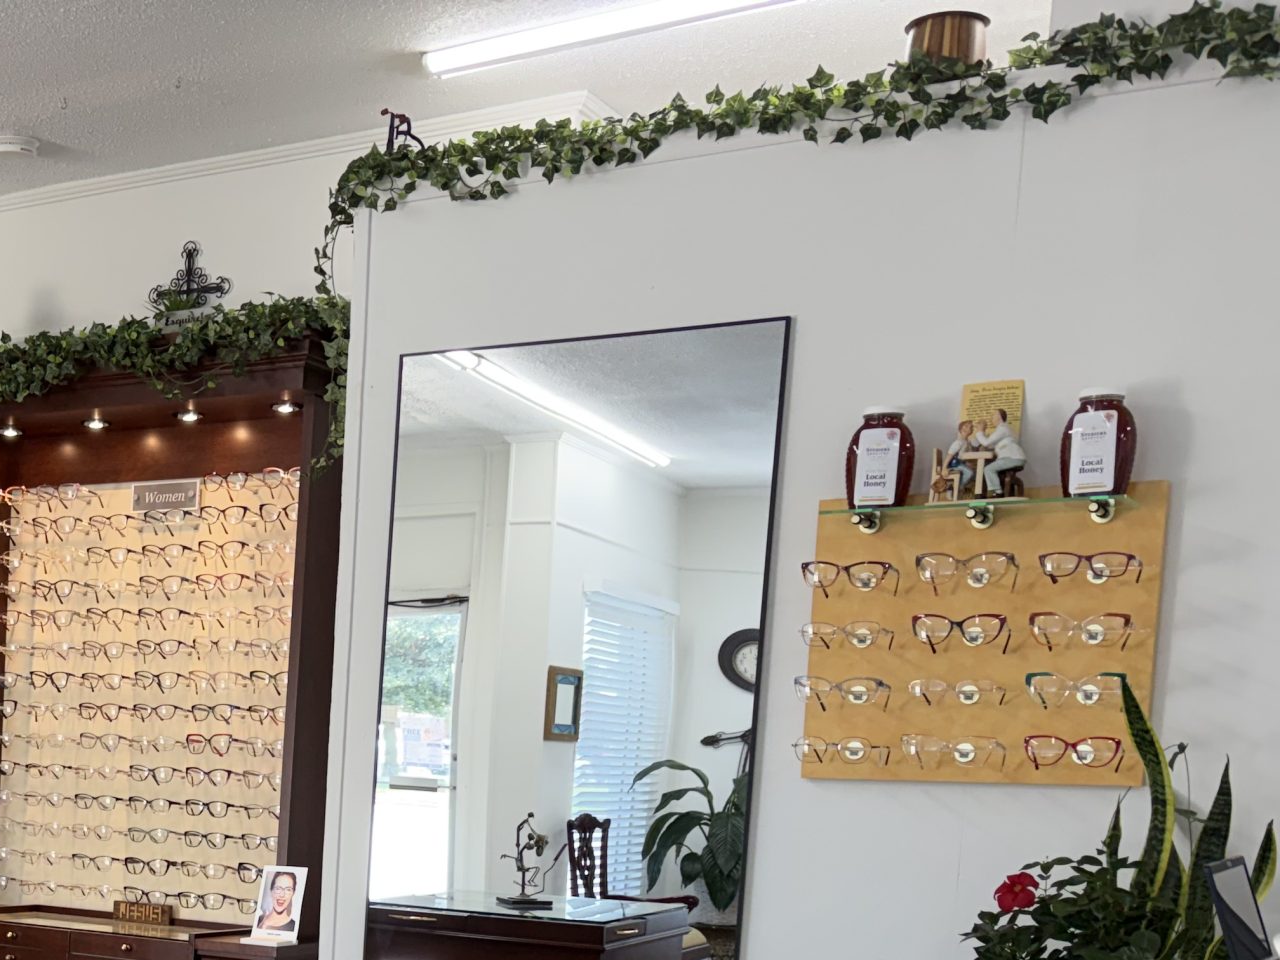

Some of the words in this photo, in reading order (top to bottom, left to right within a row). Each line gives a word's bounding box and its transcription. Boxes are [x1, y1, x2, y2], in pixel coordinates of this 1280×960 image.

[1081, 458, 1104, 467] Local
[1078, 466, 1105, 474] Honey
[863, 480, 887, 488] Honey
[144, 491, 186, 504] Women
